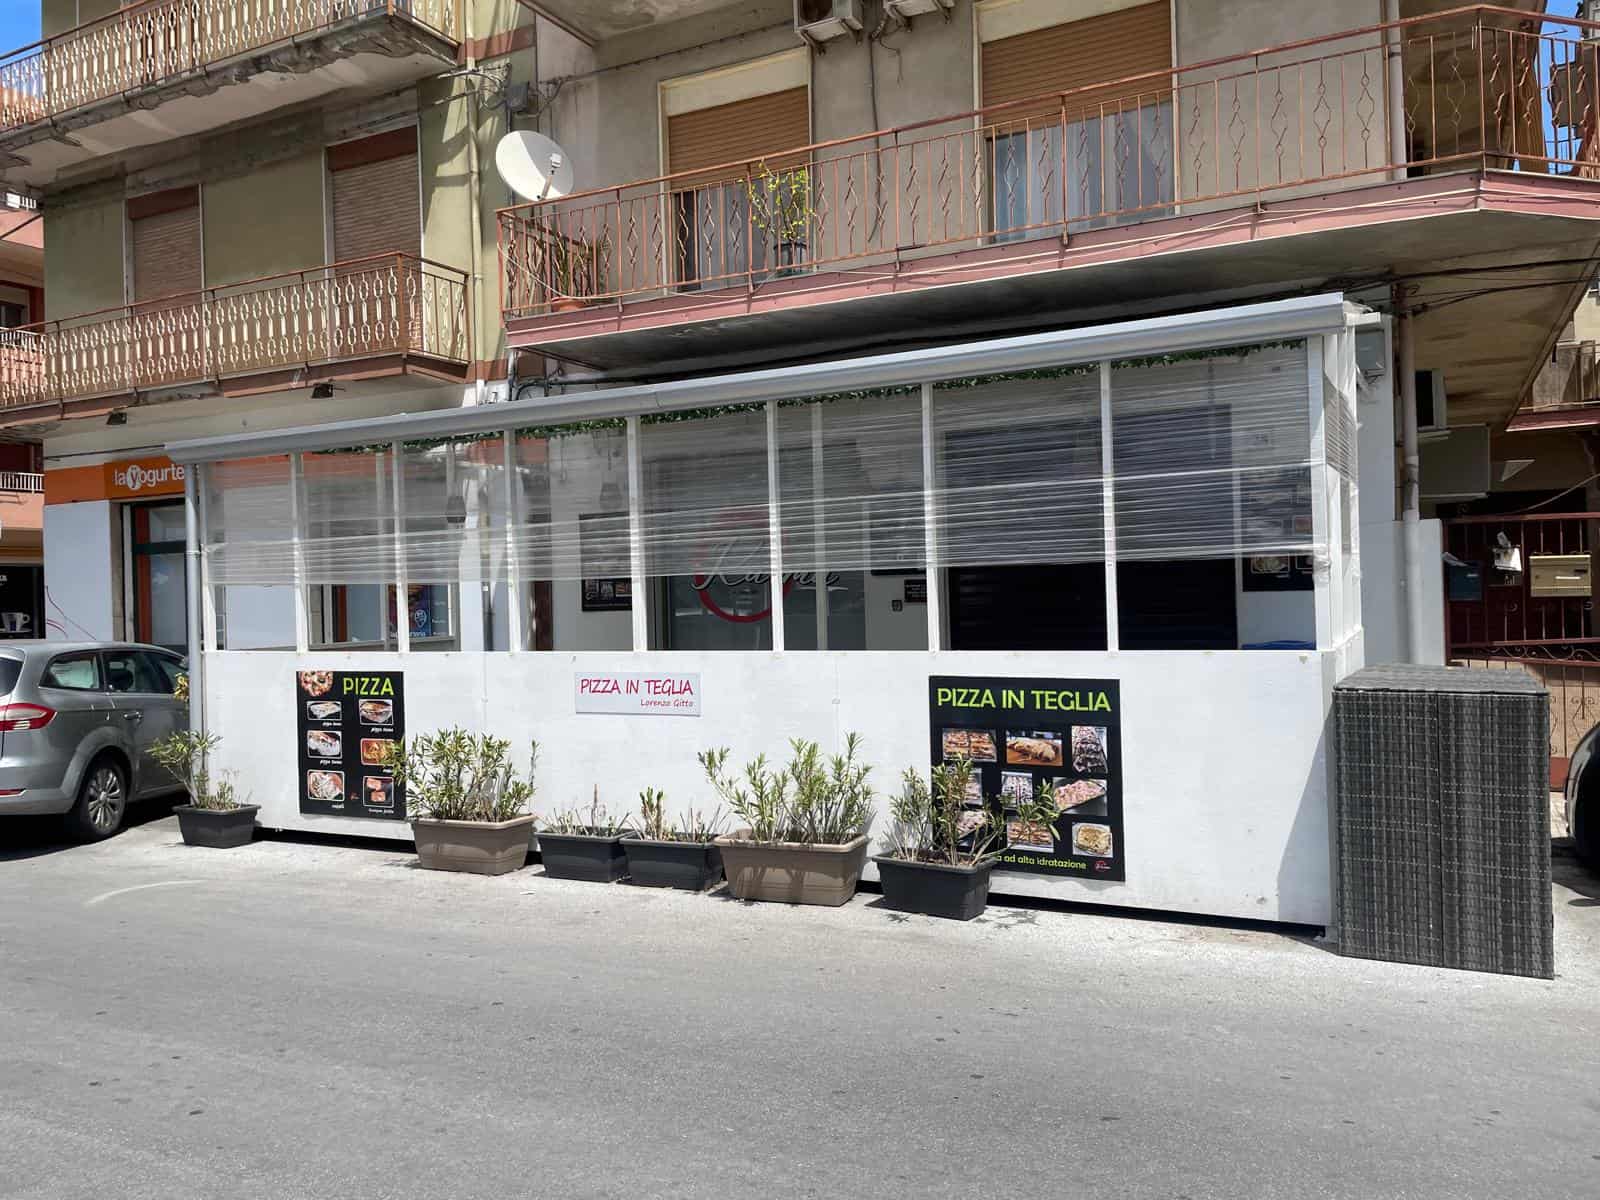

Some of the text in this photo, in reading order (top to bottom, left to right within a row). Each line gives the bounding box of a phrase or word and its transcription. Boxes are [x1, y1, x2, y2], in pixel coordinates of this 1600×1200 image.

[343, 677, 394, 696] PIZZA
[580, 678, 694, 697] PIZZA IN TEGLIA
[640, 698, 694, 708] Lorenzo Gitto
[936, 687, 1112, 712] PIZZA IN TEGLIA
[1003, 854, 1016, 863] ad
[1017, 855, 1035, 865] alta
[1036, 856, 1087, 870] idratazione
